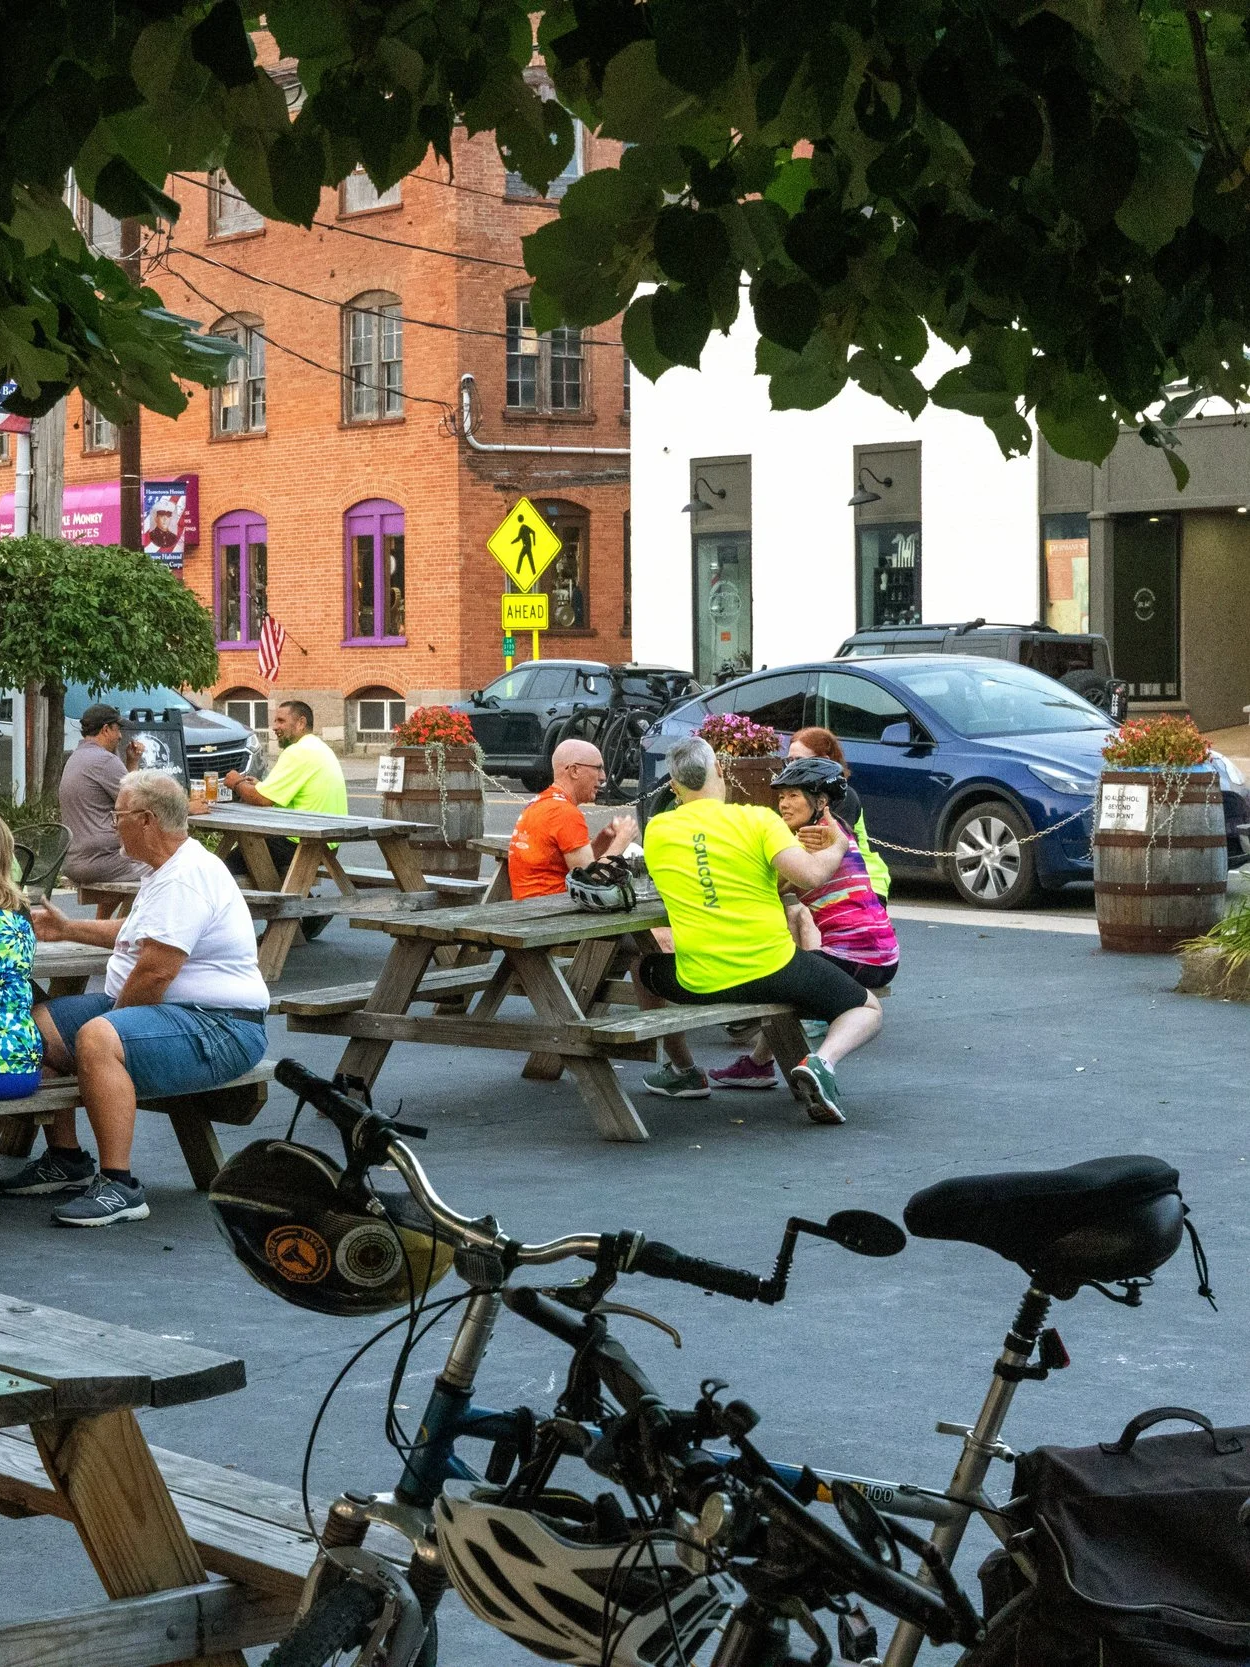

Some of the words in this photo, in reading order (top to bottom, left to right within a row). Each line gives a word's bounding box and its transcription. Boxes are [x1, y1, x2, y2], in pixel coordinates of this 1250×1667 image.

[73, 512, 103, 525] MONKEY
[61, 527, 100, 539] NTIQUES
[506, 604, 545, 619] AHEAD
[1108, 803, 1131, 811] BEYOND
[692, 832, 721, 909] saucony
